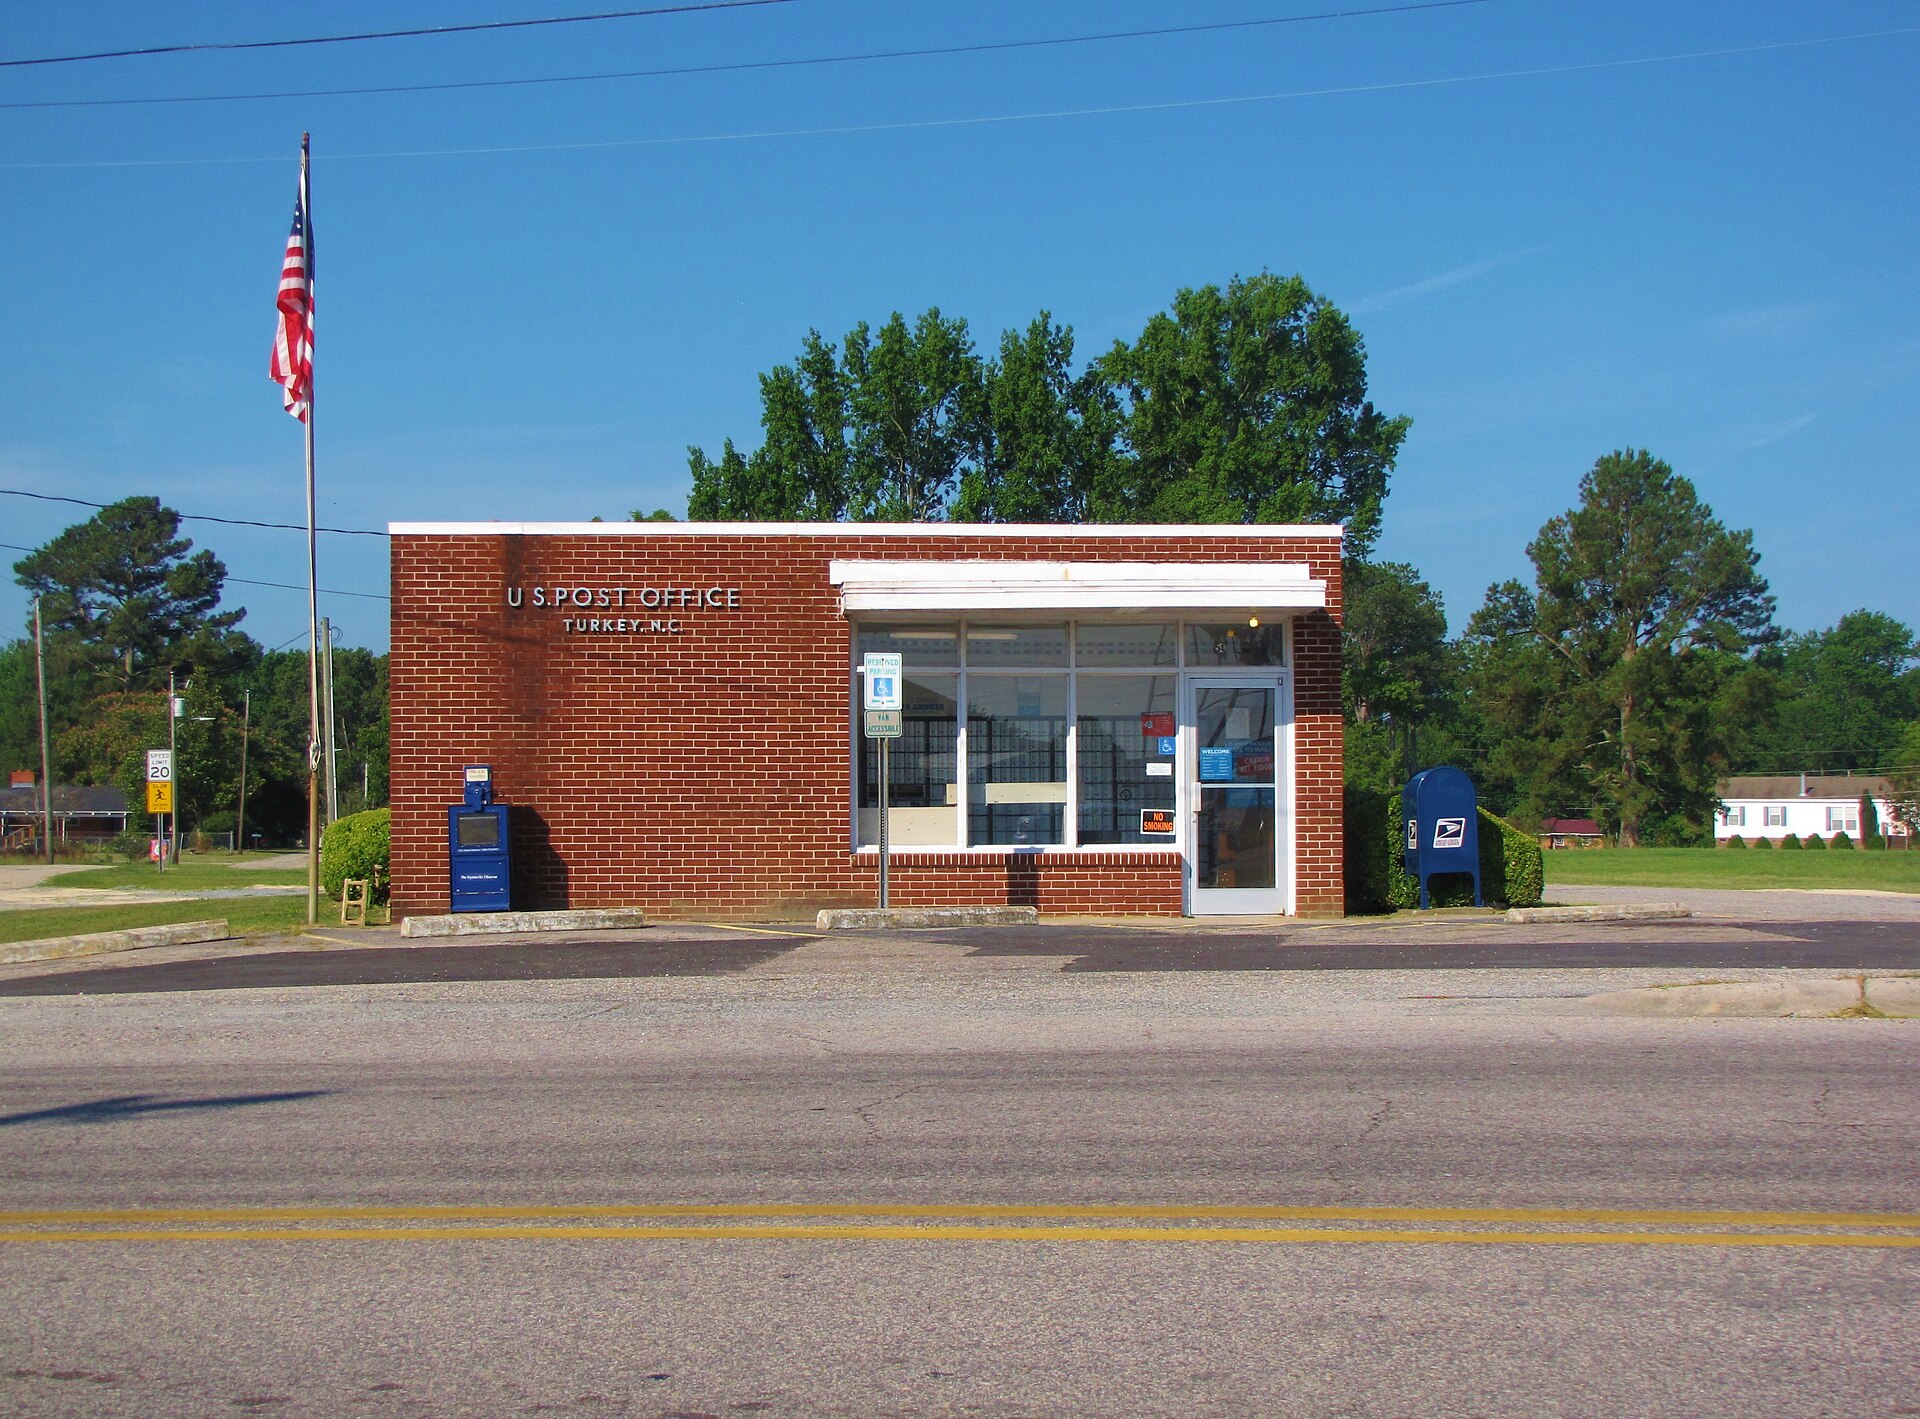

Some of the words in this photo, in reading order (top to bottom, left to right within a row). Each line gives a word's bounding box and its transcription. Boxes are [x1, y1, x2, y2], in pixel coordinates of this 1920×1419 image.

[508, 587, 522, 607] U
[640, 587, 740, 608] OFFICE
[150, 766, 169, 778] 20
[1153, 812, 1164, 821] NO
[1143, 821, 1173, 831] SMOKING
